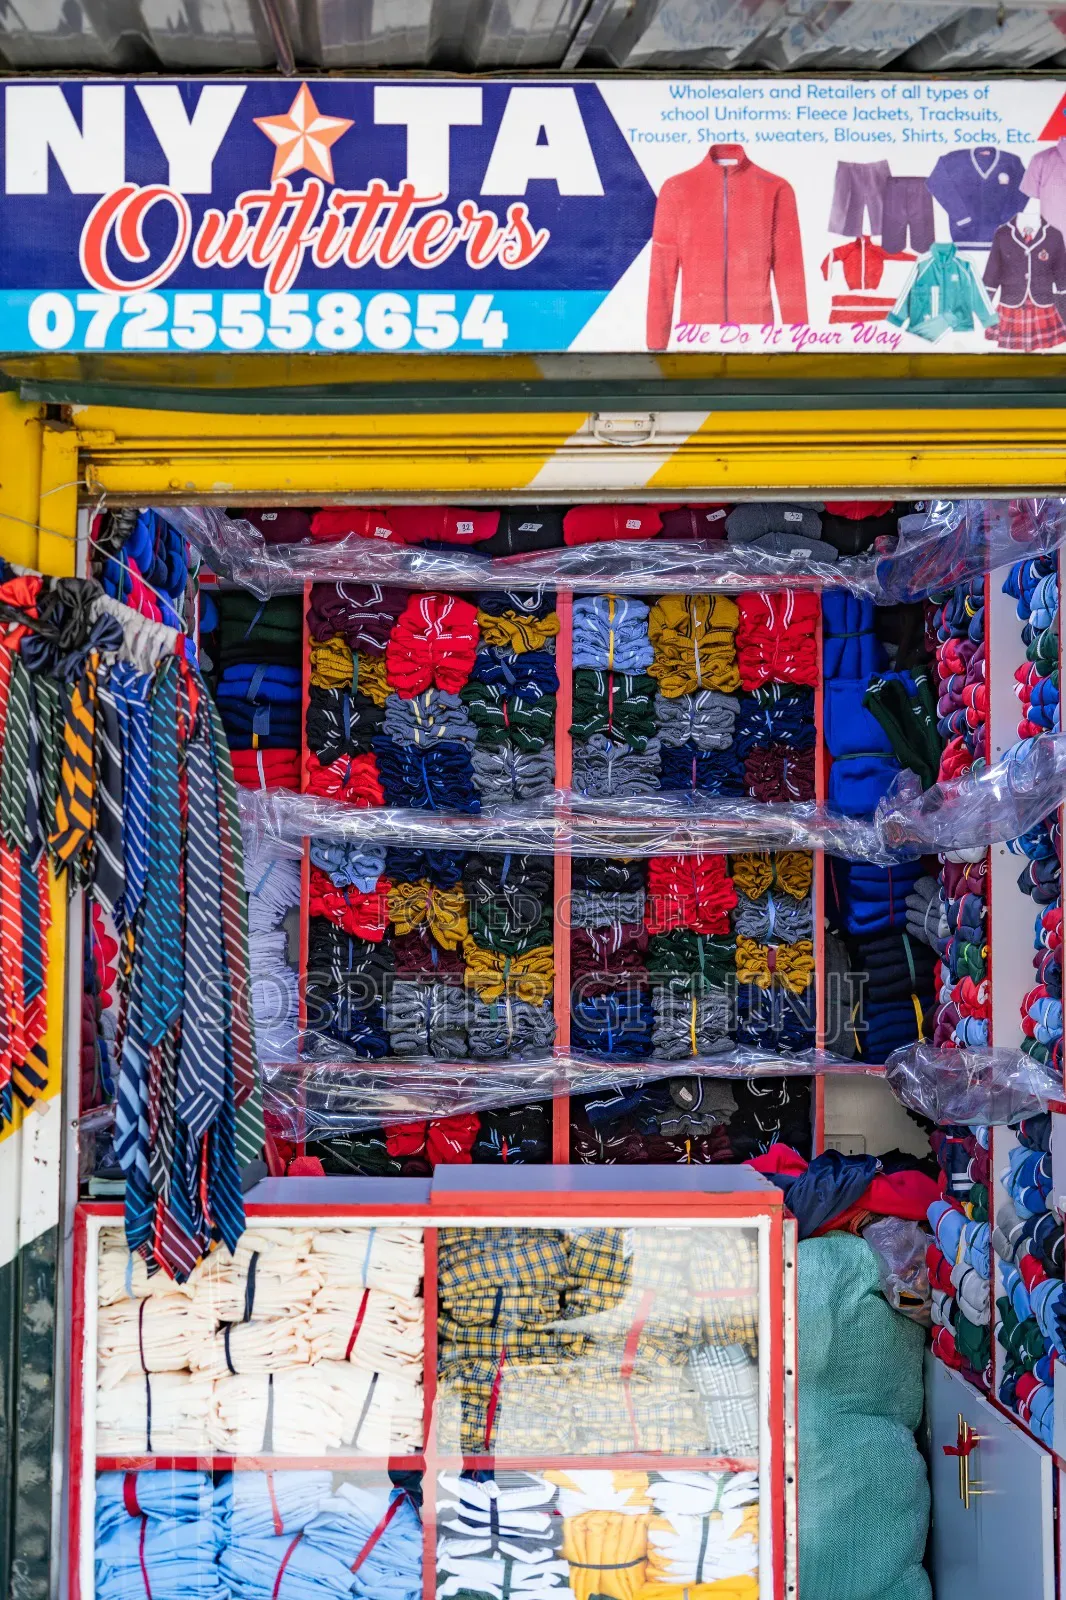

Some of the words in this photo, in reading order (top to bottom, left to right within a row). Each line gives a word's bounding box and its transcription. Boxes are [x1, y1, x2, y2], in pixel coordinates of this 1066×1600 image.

[669, 84, 765, 100] Wholesalers
[769, 84, 801, 99] and
[807, 84, 876, 99] Retailers
[881, 84, 897, 99] of
[902, 84, 921, 99] all
[926, 86, 969, 102] types
[973, 84, 990, 100] of
[661, 106, 709, 121] school
[715, 106, 792, 121] Uniforms:
[796, 106, 848, 121] Fleece
[852, 106, 914, 122] Jackets,
[919, 106, 1003, 123] Tracksuits,
[5, 85, 247, 194] NY
[374, 86, 605, 196] TA
[628, 128, 692, 144] Trouser,
[697, 128, 750, 144] Shorts,
[755, 129, 829, 144] sweaters,
[834, 128, 896, 144] Blouses,
[902, 128, 949, 144] Shirts,
[954, 128, 1001, 144] Socks,
[1006, 129, 1036, 143] Etc.
[80, 178, 550, 294] Outfitters
[28, 292, 509, 350] 0725558654
[674, 322, 711, 345] We
[719, 322, 750, 345] Do
[760, 322, 783, 344] It
[789, 322, 842, 351] Your
[851, 322, 904, 351] Way
